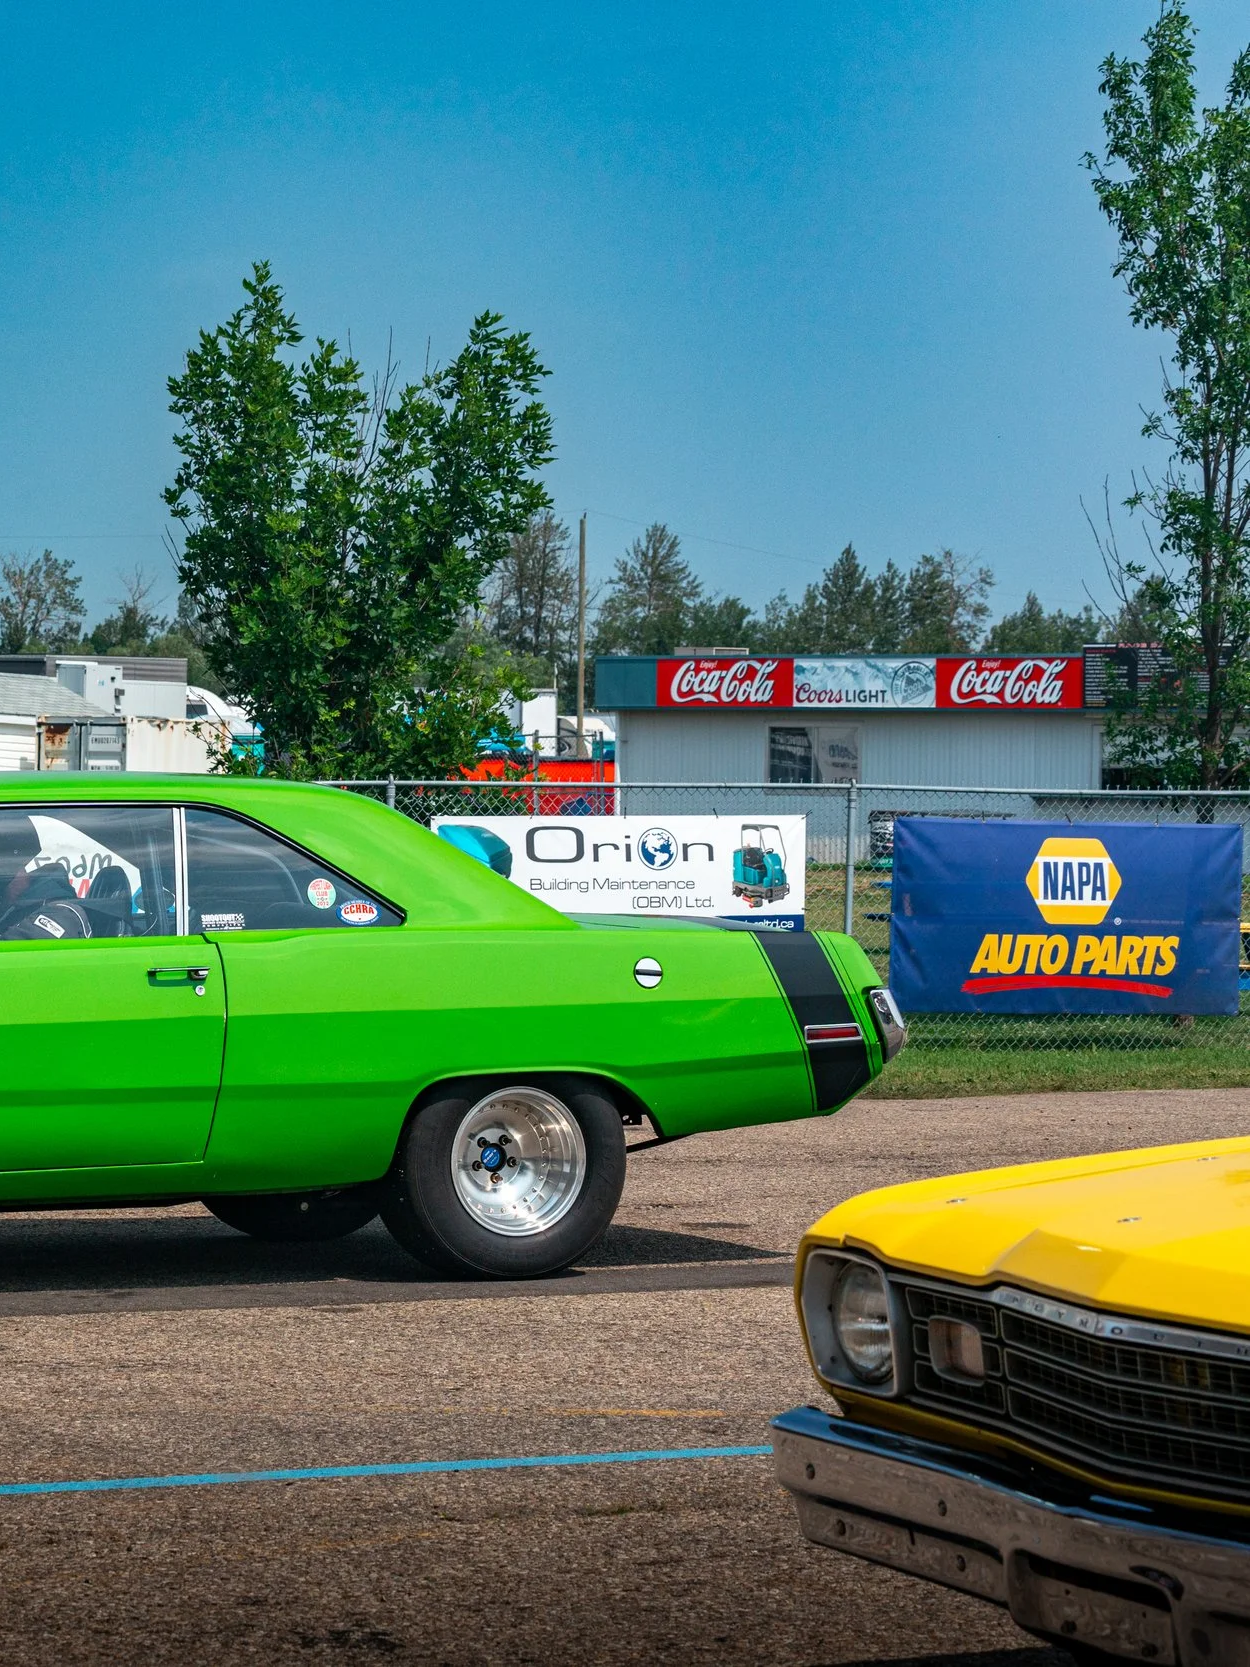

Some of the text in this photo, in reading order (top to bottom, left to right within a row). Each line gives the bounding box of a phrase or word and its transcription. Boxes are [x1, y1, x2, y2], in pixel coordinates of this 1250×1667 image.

[699, 660, 718, 669] Enjoy!
[981, 660, 1002, 669] Enjoy!
[670, 660, 779, 704] Coca-Cola
[950, 660, 1069, 704] Coca-Cola
[795, 682, 844, 703] Coors
[845, 689, 887, 703] LIGHT
[530, 877, 696, 893] Building Maintenance
[1042, 861, 1107, 901] NAPA
[344, 904, 375, 915] CCHRA
[632, 896, 715, 909] (OBM) Ltd.
[969, 933, 1180, 976] AUTO PARTS
